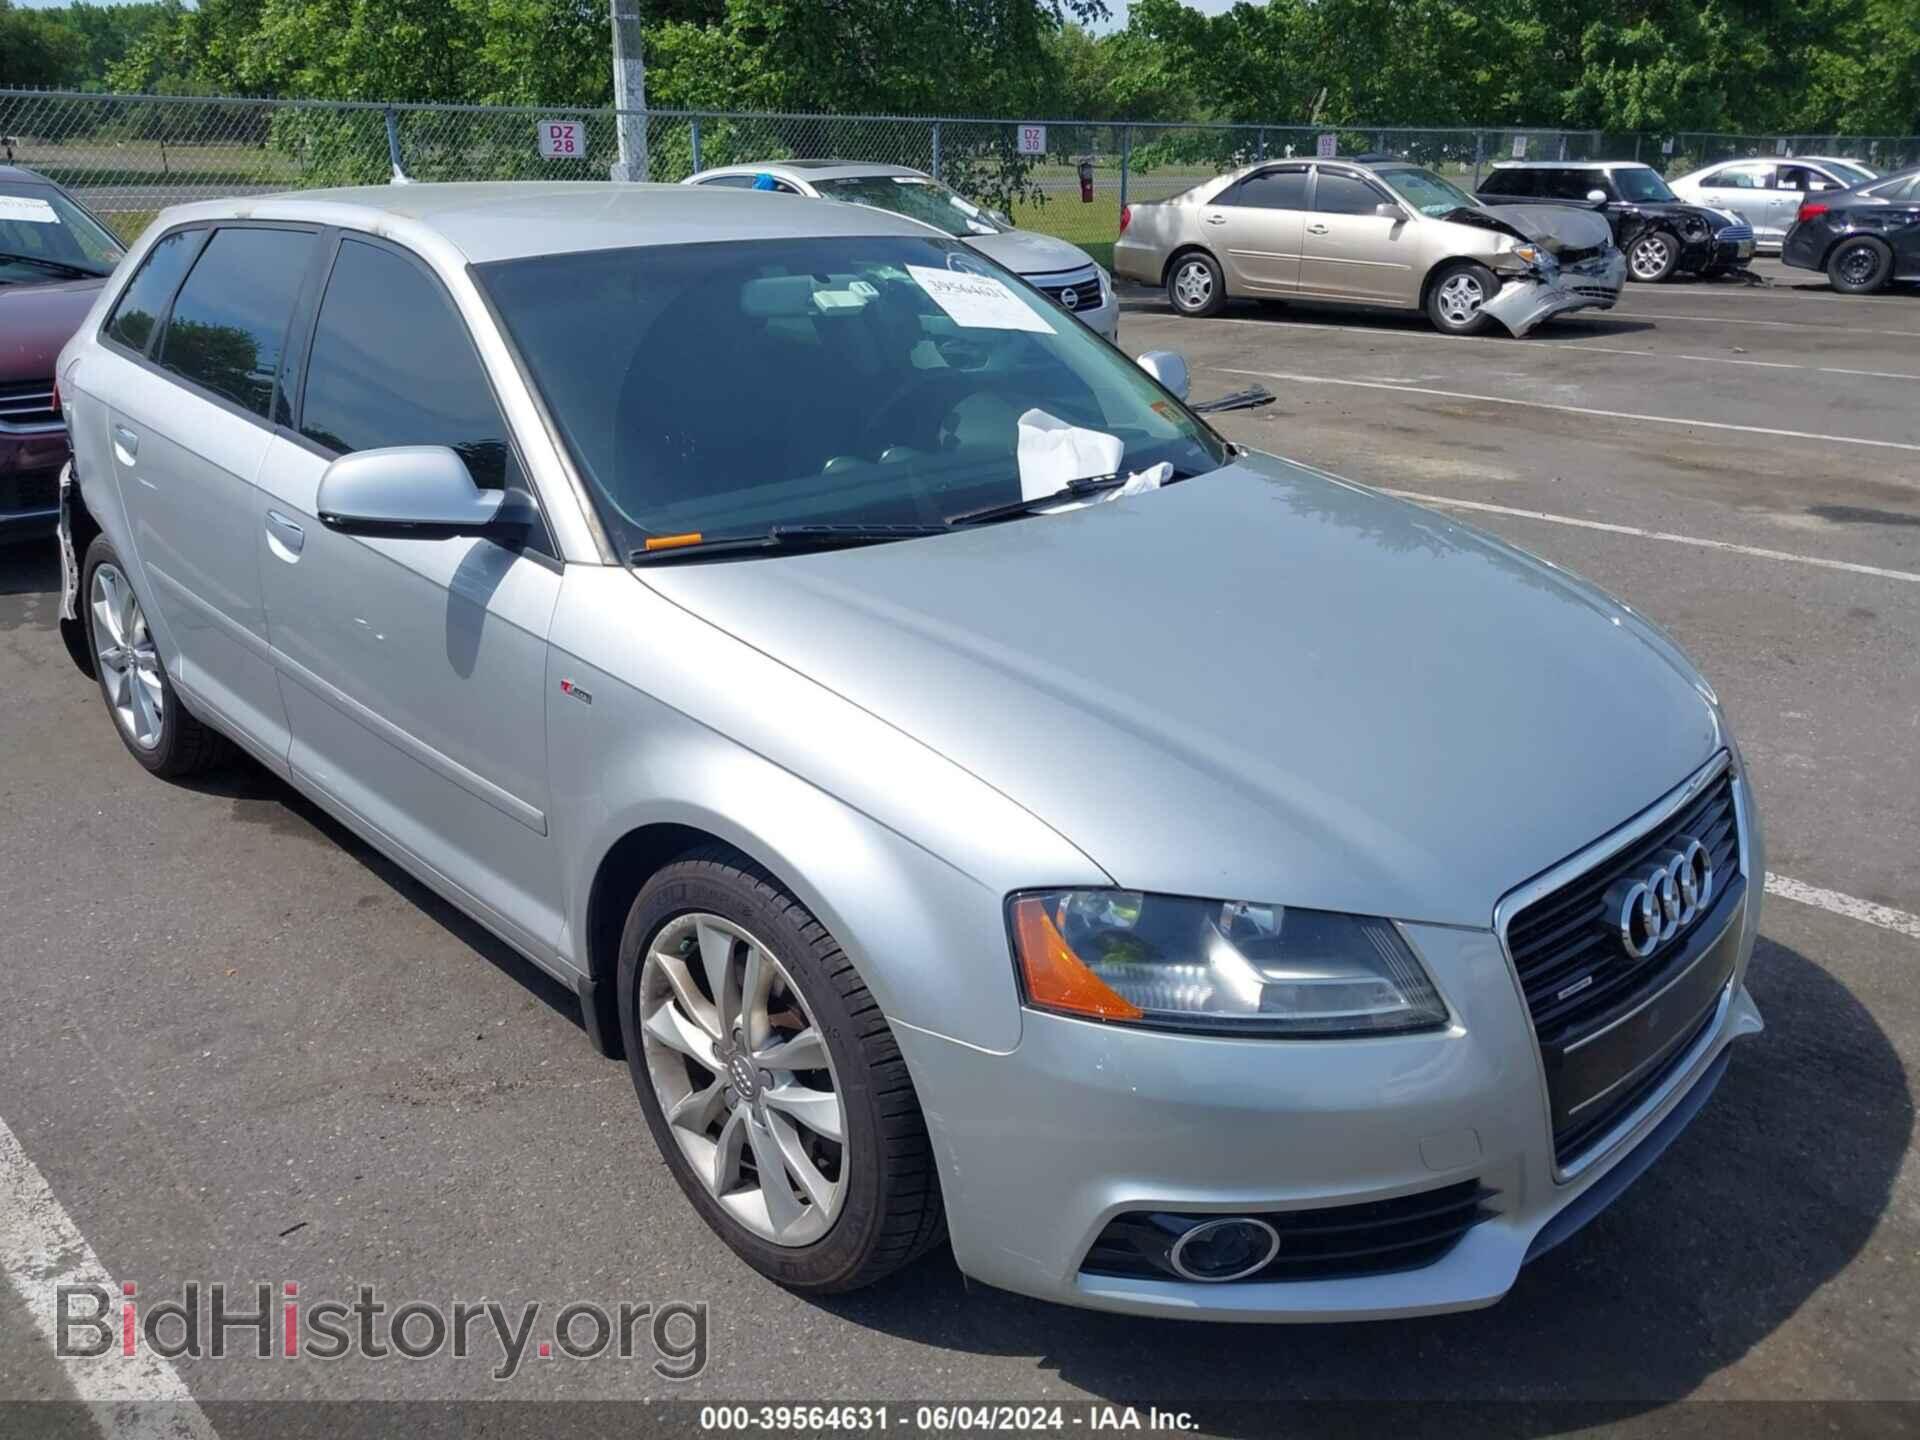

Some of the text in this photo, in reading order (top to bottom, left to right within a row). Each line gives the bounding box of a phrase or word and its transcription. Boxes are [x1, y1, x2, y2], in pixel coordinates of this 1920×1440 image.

[550, 125, 574, 139] DZ
[1025, 129, 1040, 140] DZ
[553, 140, 574, 152] 28
